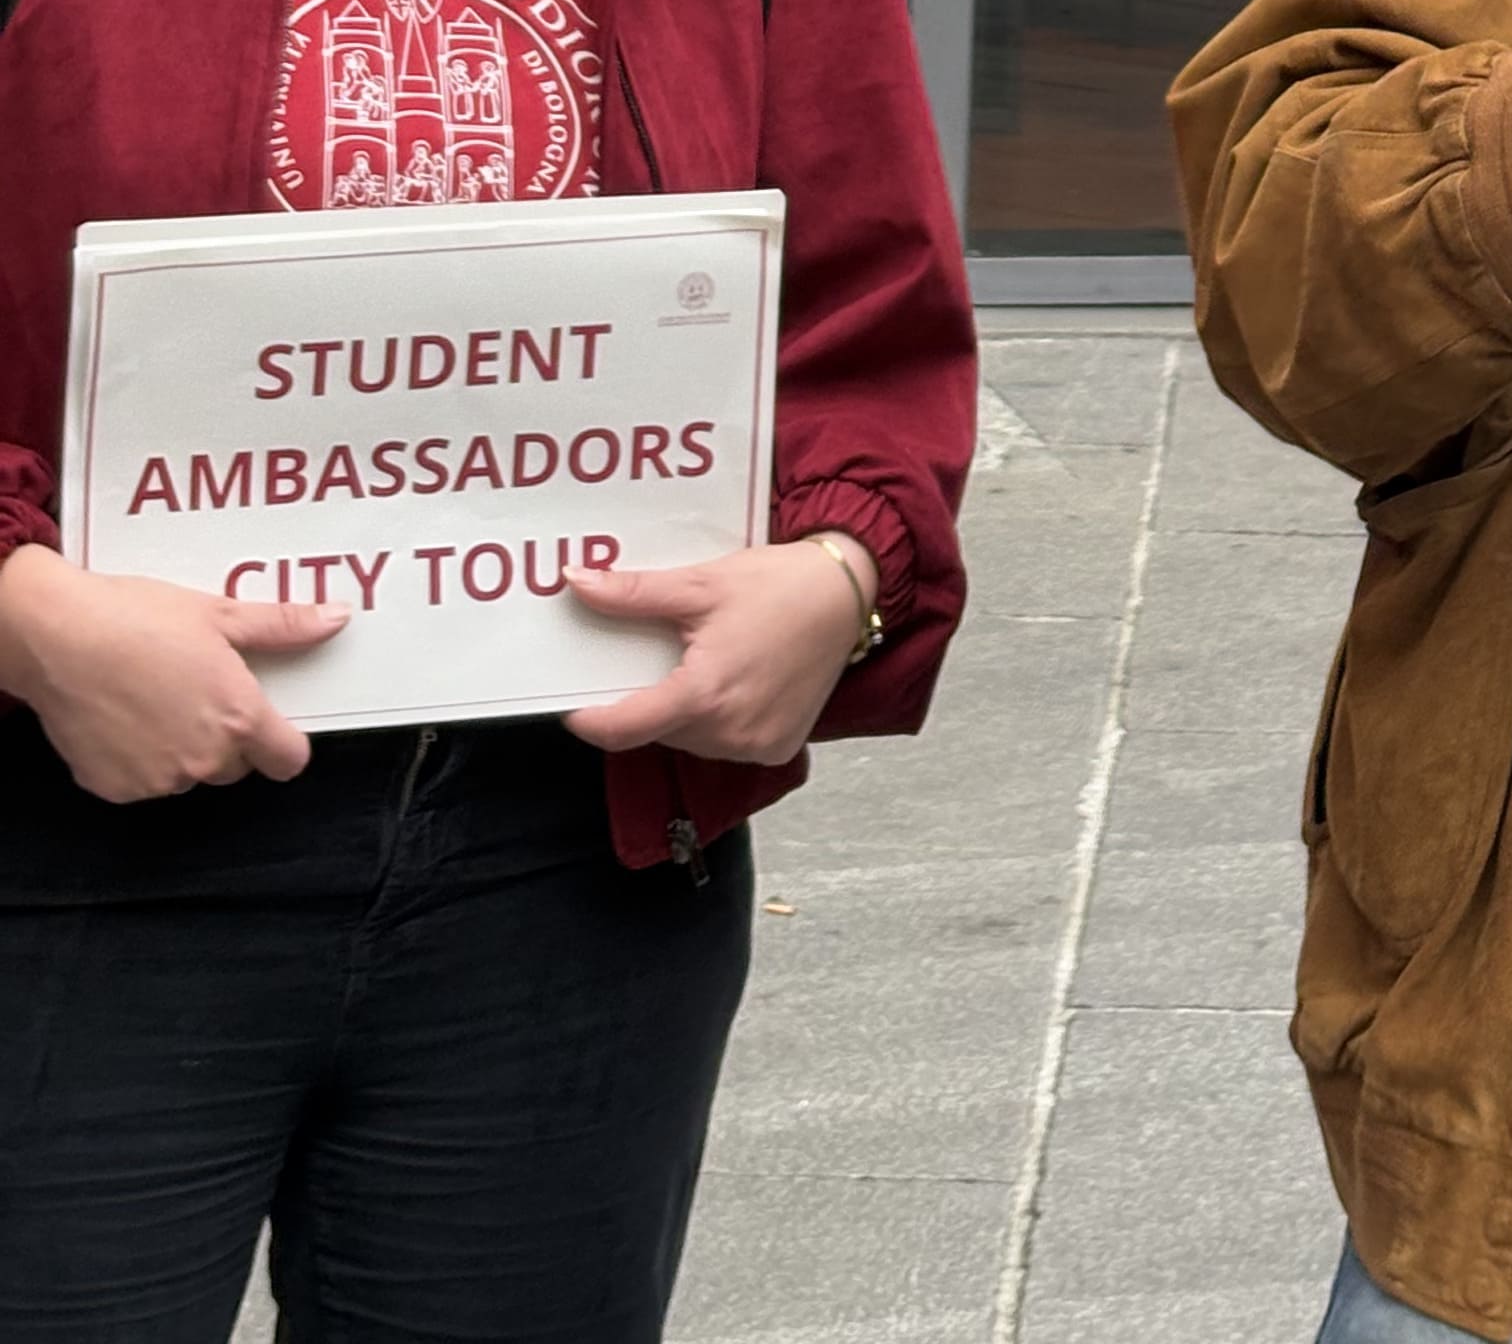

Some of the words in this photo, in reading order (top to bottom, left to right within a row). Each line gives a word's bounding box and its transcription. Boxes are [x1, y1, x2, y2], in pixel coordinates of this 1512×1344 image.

[521, 50, 549, 76] DI
[525, 80, 568, 194] BOLOGNA
[254, 324, 612, 400] STUDENT
[127, 421, 716, 516] AMBASSADORS
[225, 551, 390, 612] CITY
[415, 535, 621, 606] TOUR
